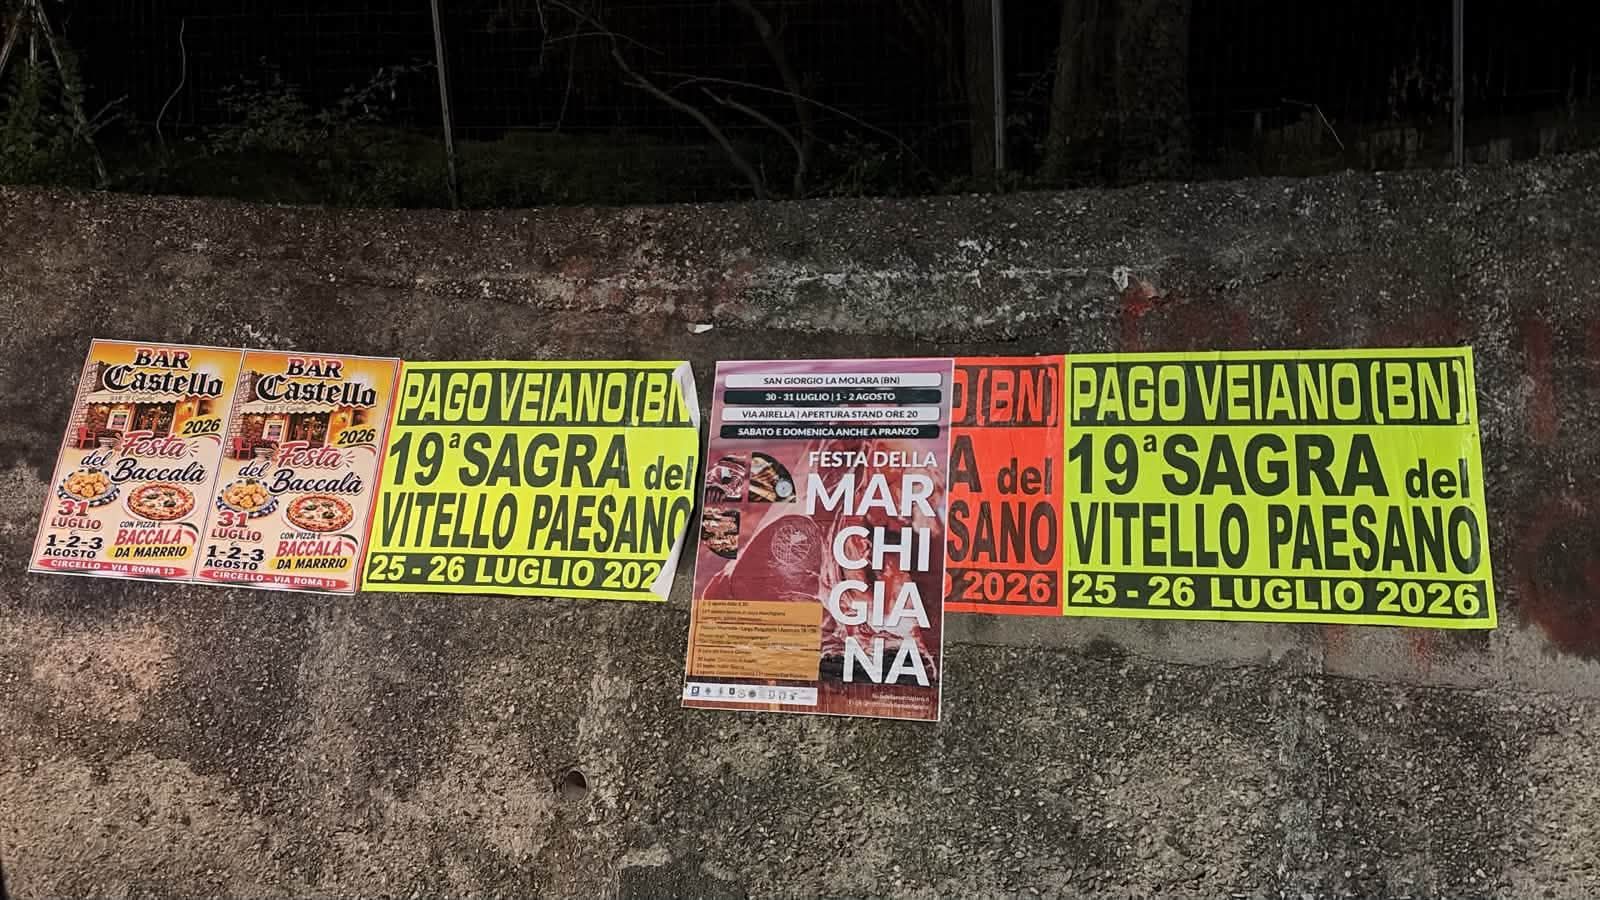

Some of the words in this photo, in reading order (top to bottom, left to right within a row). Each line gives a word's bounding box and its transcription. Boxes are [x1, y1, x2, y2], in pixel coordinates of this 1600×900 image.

[134, 349, 190, 369] BAR
[286, 358, 344, 379] BAR
[103, 365, 223, 396] Castello
[257, 375, 377, 406] Castello
[763, 377, 782, 385] SAN
[784, 377, 823, 385] GIORGIO
[825, 377, 838, 385] LA
[838, 377, 880, 385] MOLARA
[880, 377, 900, 385] (BN)
[400, 372, 493, 421] PAGO
[501, 372, 627, 423] VEIANO
[631, 372, 690, 426] (BN
[765, 393, 777, 401] 30
[783, 393, 793, 401] 31
[796, 393, 830, 401] LUGLIO
[836, 393, 841, 401] 1
[848, 393, 855, 401] 2
[855, 393, 896, 401] AGOSTO
[1073, 365, 1186, 422] PAGO
[1195, 362, 1362, 421] VEIANO
[758, 411, 795, 419] AIRELLA
[801, 410, 850, 418] APERTURA
[852, 410, 883, 418] STAND
[885, 410, 905, 418] ORE
[906, 410, 918, 418] 20
[183, 419, 221, 434] 2026
[338, 429, 375, 444] 2026
[737, 428, 775, 436] SABATO
[776, 428, 782, 436] E
[783, 428, 835, 437] DOMENICA
[835, 428, 869, 436] ANCHE
[870, 428, 877, 436] A
[879, 427, 919, 436] PRANZO
[122, 431, 187, 457] Festa
[278, 442, 343, 467] Festa
[459, 432, 631, 488] SAGRA
[644, 455, 694, 491] del
[808, 451, 869, 467] FESTA
[873, 451, 938, 468] DELLA
[81, 452, 110, 466] del
[111, 458, 205, 482] Baccalà
[997, 457, 1053, 495] del
[1162, 433, 1390, 496] SAGRA
[1405, 458, 1470, 499] del
[238, 463, 269, 477] del
[269, 469, 363, 493] Baccalà
[806, 473, 936, 517] MAR
[58, 501, 89, 516] 31
[51, 517, 102, 529] LUGLIO
[217, 512, 248, 528] 31
[382, 492, 518, 550] VITELLO
[527, 494, 692, 553] PAESANO
[46, 535, 103, 549] 1-2-3
[114, 525, 183, 545] BACCALÀ
[211, 529, 262, 541] LUGLIO
[947, 500, 1057, 565] SANO
[1070, 501, 1249, 569] VITELLO
[1267, 504, 1482, 574] PAESANO
[43, 548, 96, 559] AGOSTO
[114, 547, 130, 558] DA
[133, 546, 187, 557] MARRRIO
[207, 546, 264, 561] 1-2-3
[276, 537, 343, 557] BACCALÀ
[833, 526, 930, 571] CHI
[51, 560, 100, 570] CIRCELLO
[131, 565, 161, 575] ROMA
[164, 567, 175, 575] 13
[205, 559, 258, 570] AGOSTO
[276, 558, 292, 569] DA
[295, 558, 347, 569] MARRRIO
[369, 555, 406, 580] 25
[427, 556, 465, 582] 26
[475, 557, 594, 586] LUGLIO
[601, 561, 661, 589] 202
[213, 571, 263, 581] CIRCELLO
[294, 576, 322, 586] ROMA
[962, 572, 1051, 602] 2026
[829, 580, 930, 629] GIA
[1071, 573, 1117, 605] 25
[1148, 576, 1195, 607] 26
[1210, 577, 1364, 611] LUGLIO
[1375, 581, 1480, 616] 2026
[842, 636, 930, 687] NA
